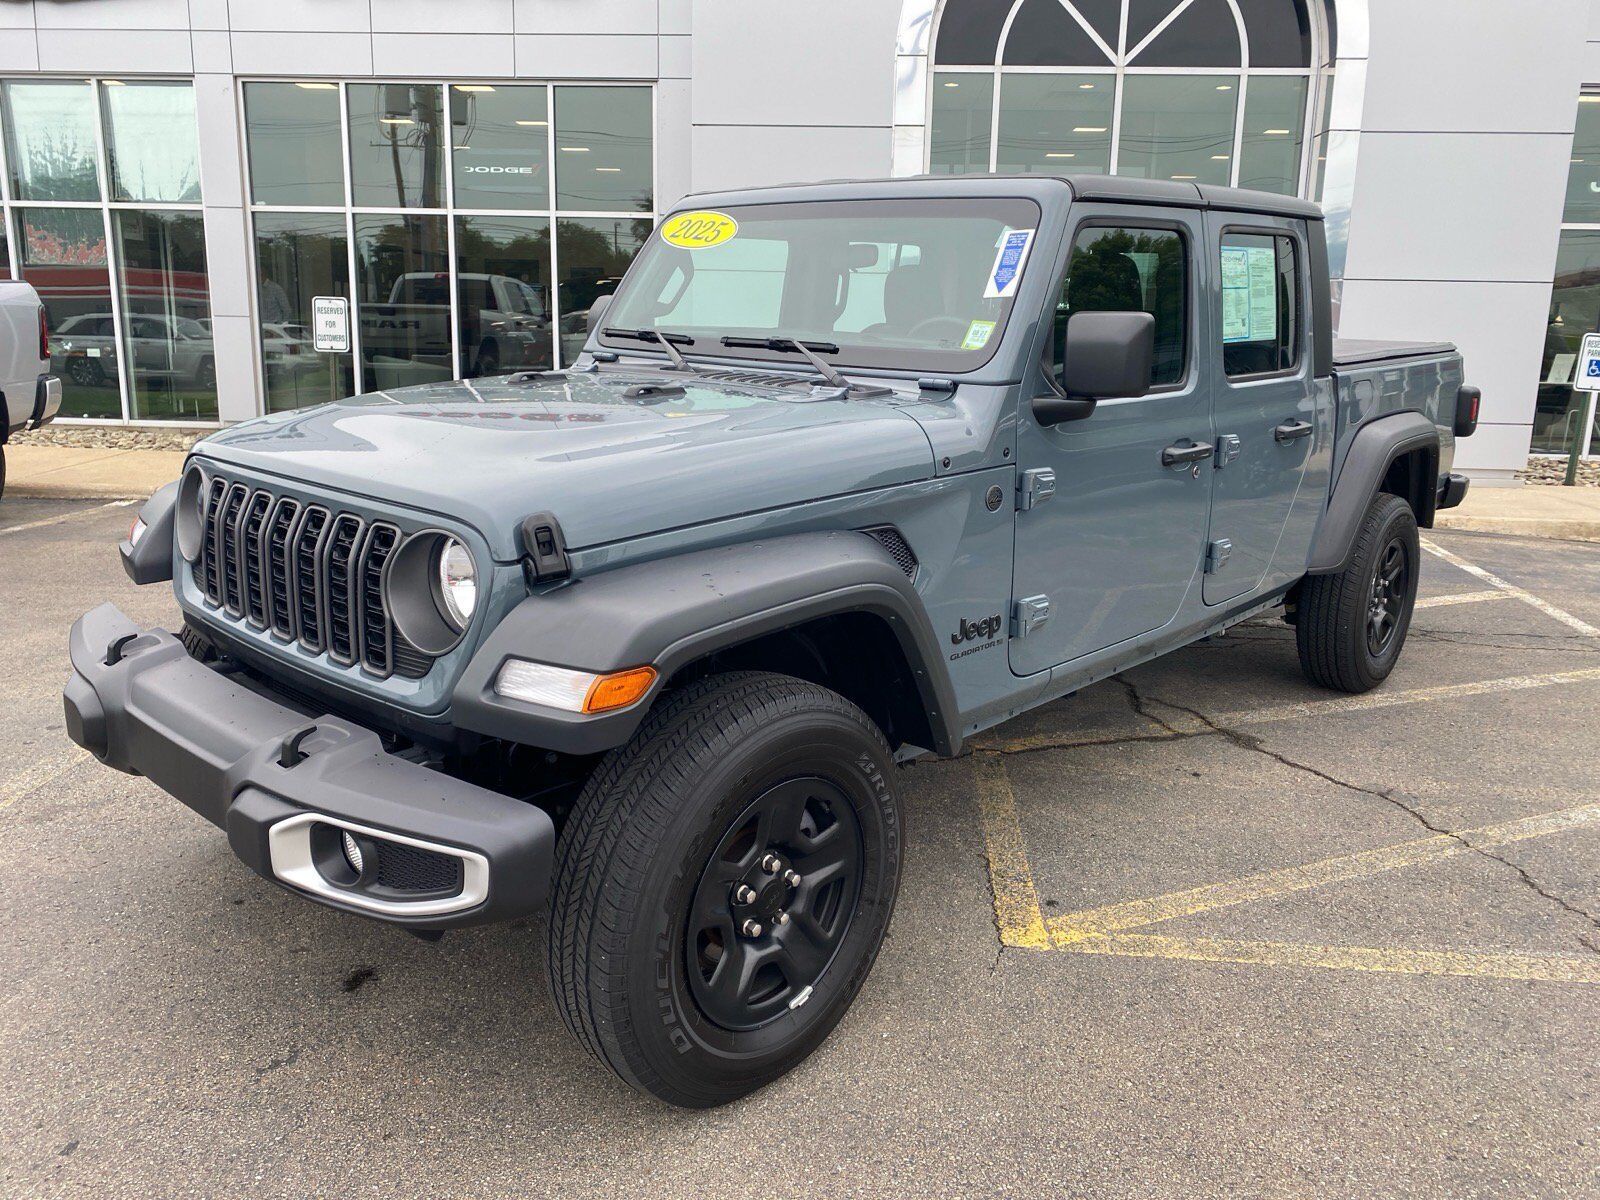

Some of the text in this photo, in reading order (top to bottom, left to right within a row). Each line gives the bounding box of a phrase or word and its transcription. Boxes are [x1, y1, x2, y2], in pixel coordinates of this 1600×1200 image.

[464, 166, 533, 174] DODGE
[670, 219, 729, 243] 2025
[317, 306, 344, 315] RESERVED
[325, 320, 337, 329] FOR
[317, 334, 346, 342] CUSTOMERS
[951, 614, 1001, 645] Jeep
[950, 640, 996, 661] GLADIATOR
